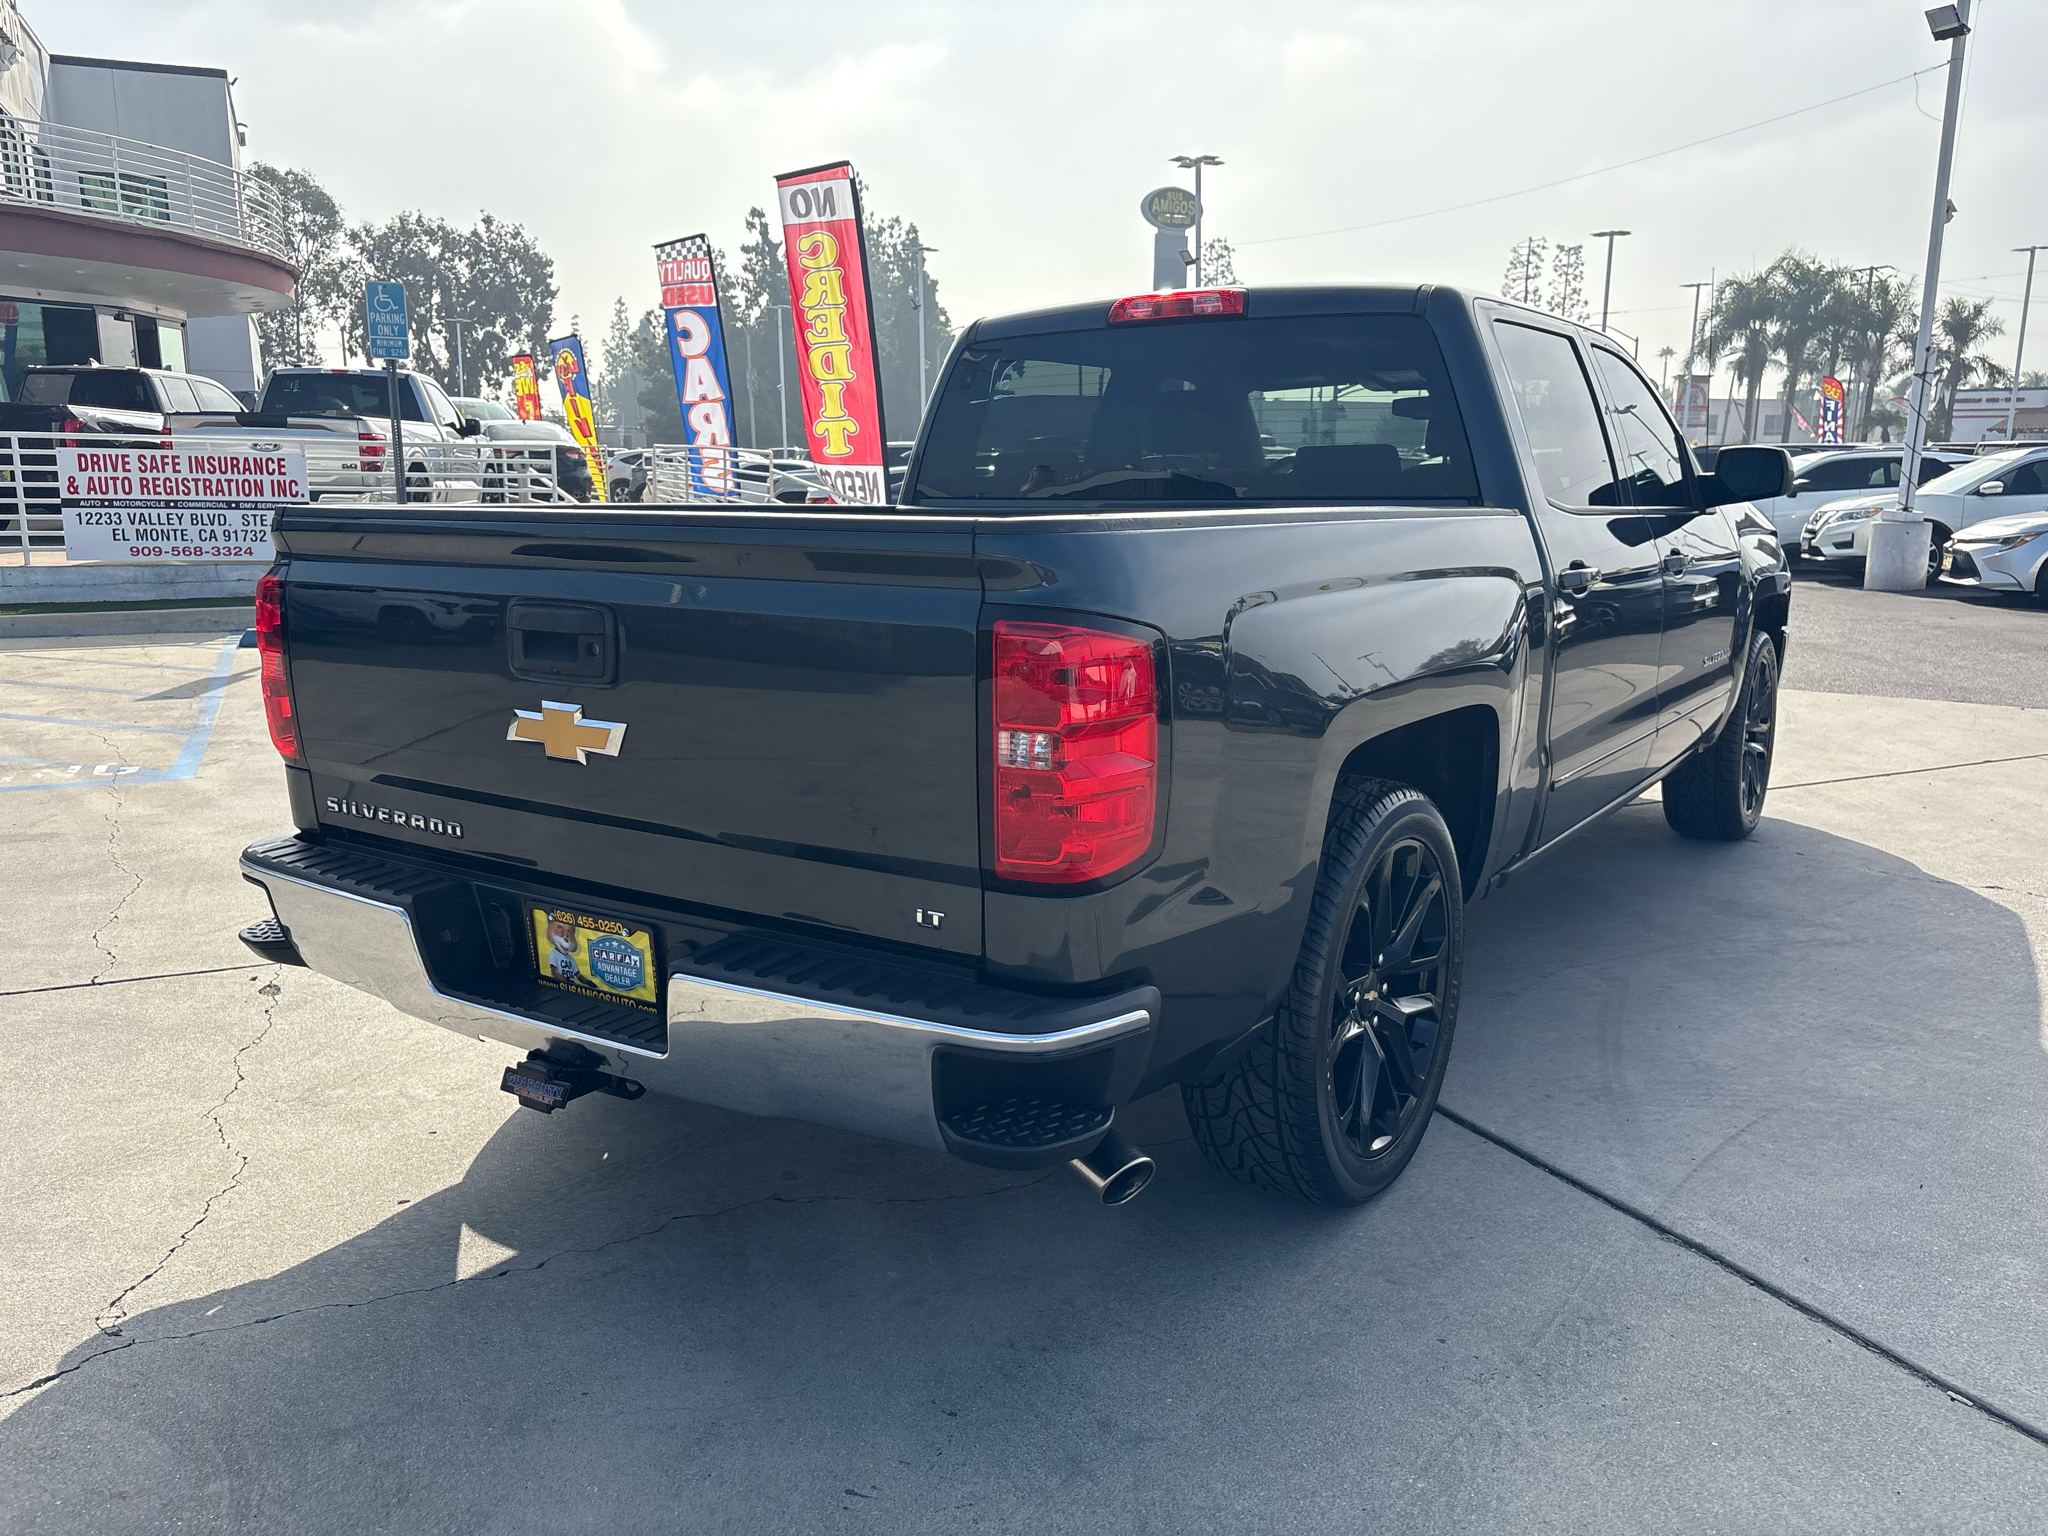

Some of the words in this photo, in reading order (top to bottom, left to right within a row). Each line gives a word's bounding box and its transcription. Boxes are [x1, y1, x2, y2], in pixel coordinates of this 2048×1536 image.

[1166, 191, 1183, 201] SUS
[1152, 197, 1196, 215] AMIGOS
[370, 311, 405, 324] PARKING
[377, 324, 399, 336] ONLY
[376, 339, 403, 347] MINIMUM
[77, 453, 131, 473] DRIVE
[137, 454, 181, 473] SAFE
[188, 455, 287, 476] INSURANCE
[66, 475, 80, 495] &
[86, 476, 132, 495] AUTO
[139, 477, 264, 497] REGISTRATION
[270, 479, 305, 498] INC.
[113, 500, 165, 508] MOTORCYCLE
[75, 512, 122, 525] 12233
[127, 512, 184, 526] VALLEY
[190, 513, 232, 527] BLVD.
[241, 513, 272, 527] STE.
[112, 528, 130, 541] EL
[135, 528, 194, 543] MONTE,
[198, 529, 218, 542] CA
[222, 529, 267, 543] 91732
[129, 545, 254, 557] 909-568-3324
[326, 796, 464, 839] SILVERADO
[553, 909, 575, 925] (626)
[577, 915, 624, 934] 455-0250
[916, 908, 946, 929] LT
[593, 949, 639, 967] CARFAX
[597, 962, 637, 978] ADVANTAGE
[604, 972, 631, 987] DEALER
[507, 1072, 563, 1098] GUARANTY
